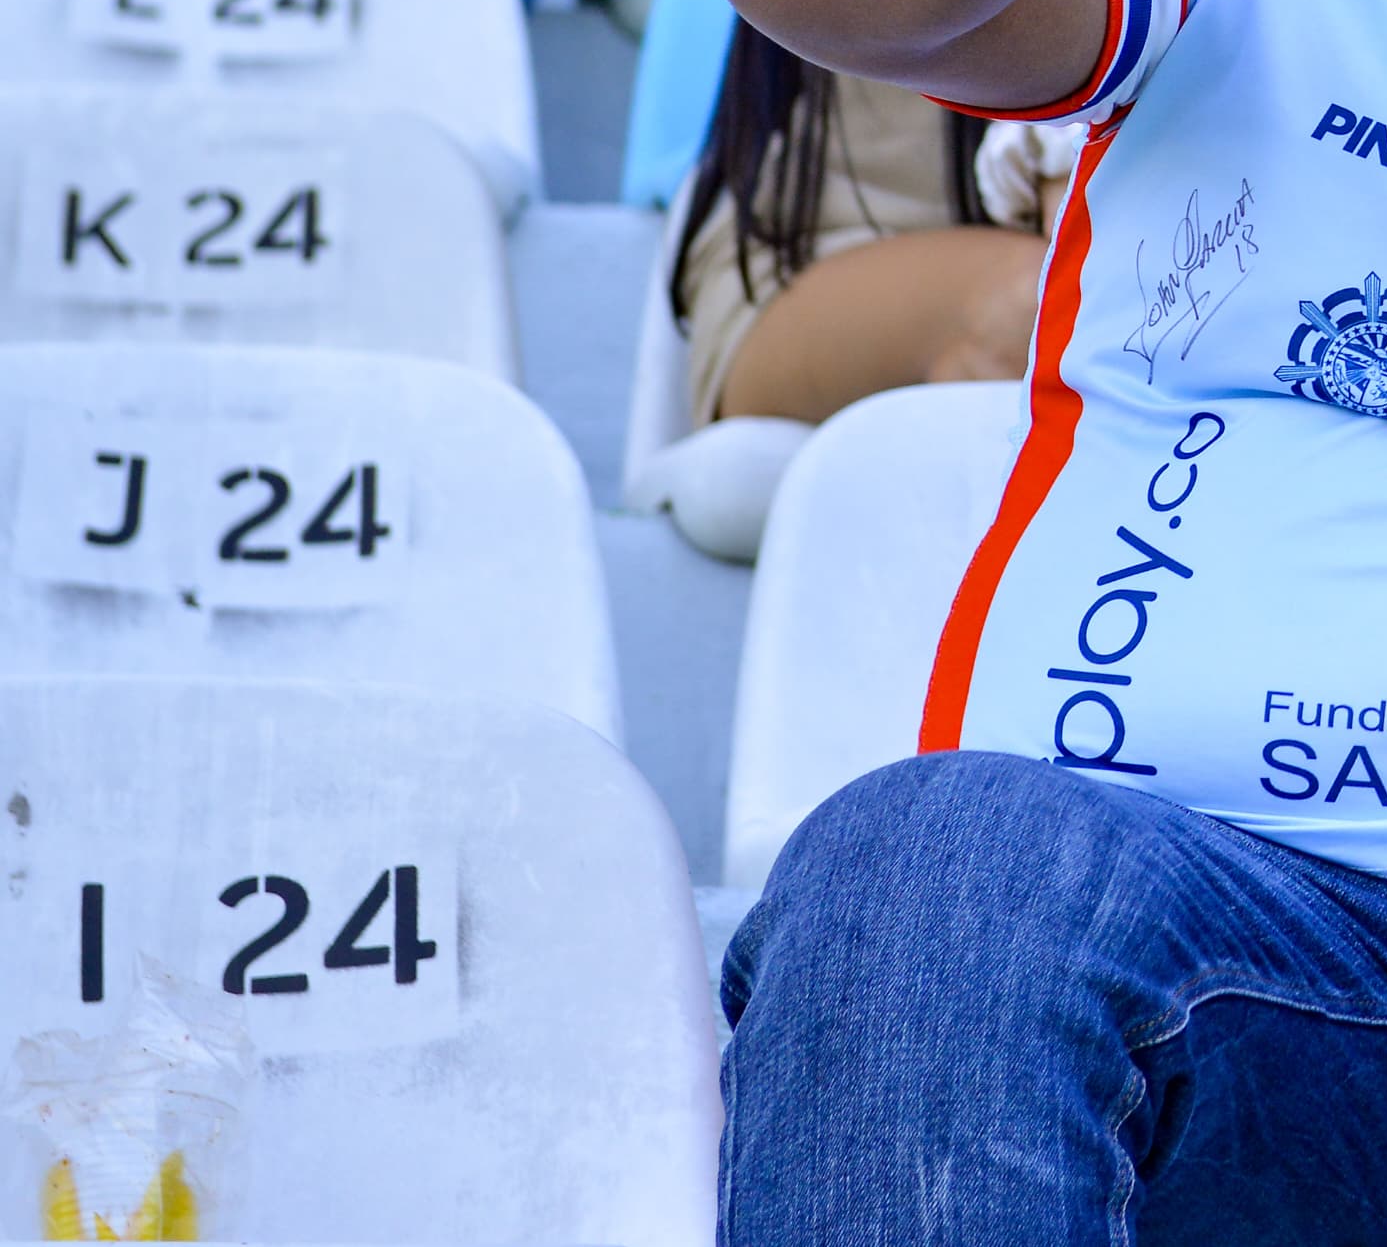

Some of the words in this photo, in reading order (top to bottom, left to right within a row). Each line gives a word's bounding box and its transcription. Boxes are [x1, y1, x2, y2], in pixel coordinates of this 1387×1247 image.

[62, 188, 133, 269] K
[184, 188, 330, 266] 24
[84, 451, 148, 547] J
[216, 462, 391, 563] 24
[1040, 411, 1226, 777] play.co
[81, 882, 105, 1003] I
[217, 863, 438, 996] 24
